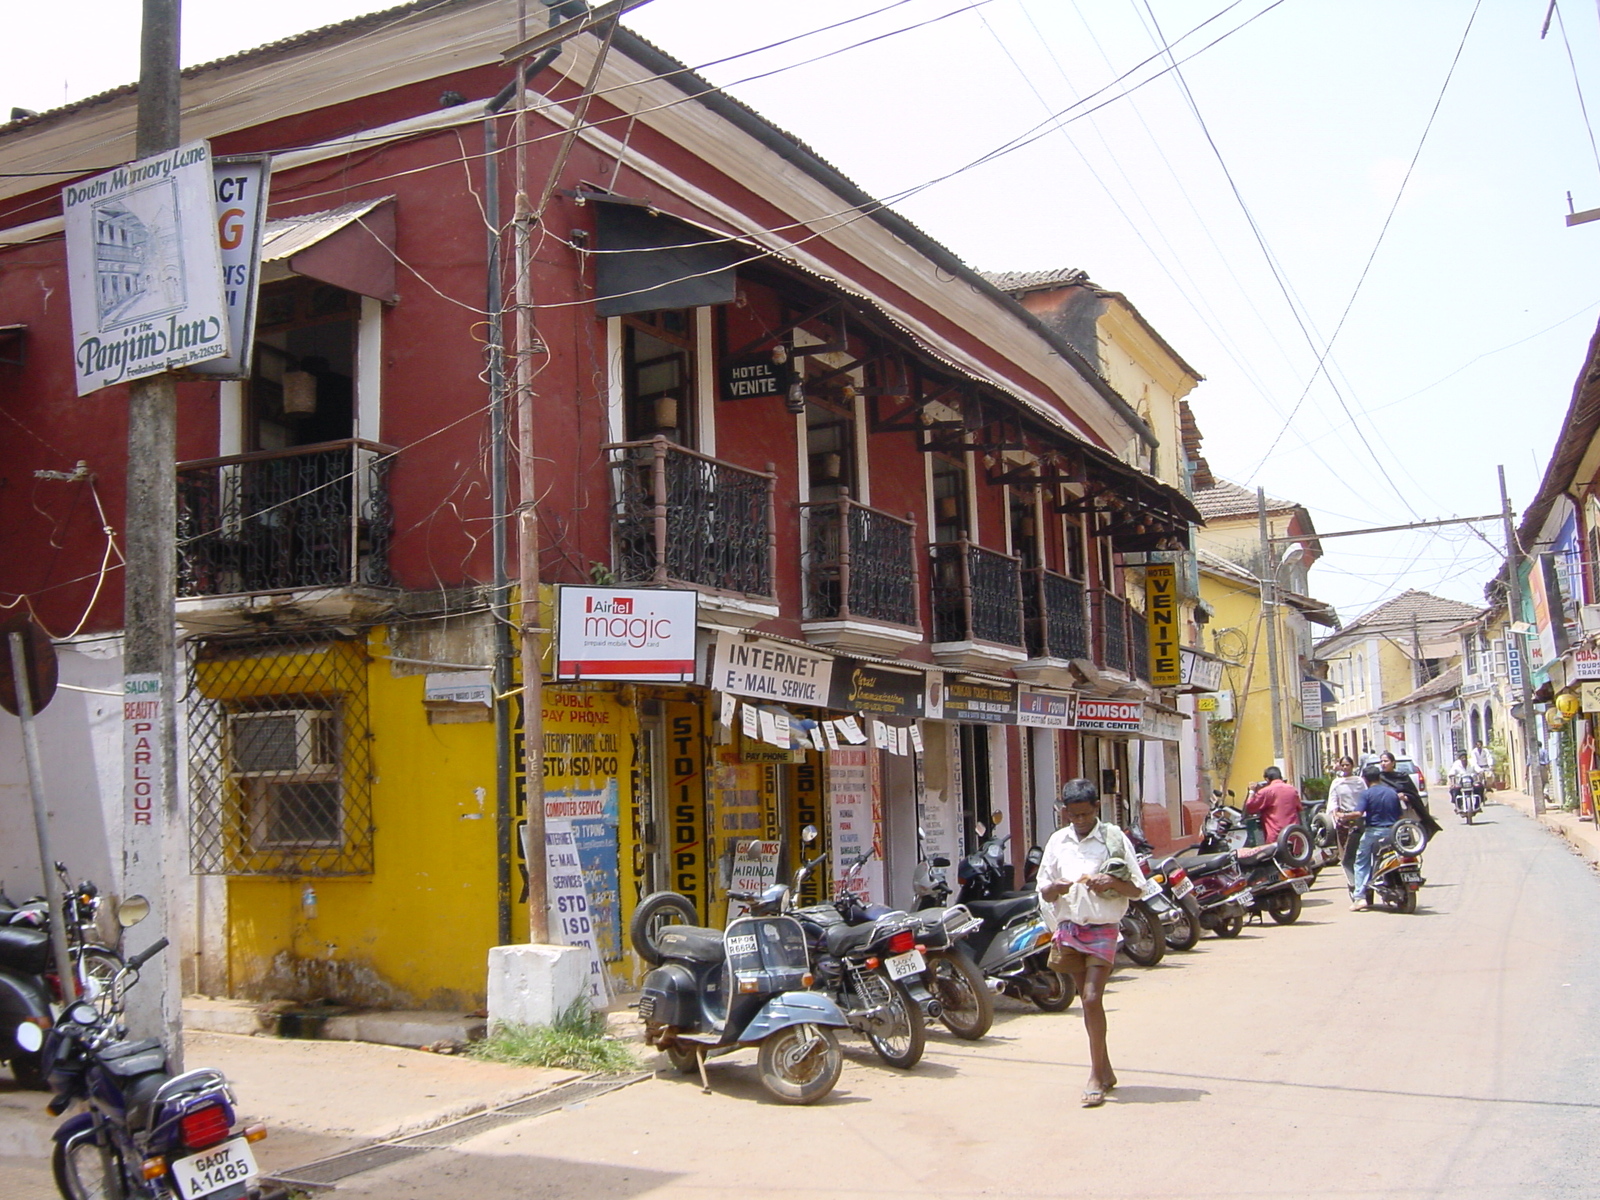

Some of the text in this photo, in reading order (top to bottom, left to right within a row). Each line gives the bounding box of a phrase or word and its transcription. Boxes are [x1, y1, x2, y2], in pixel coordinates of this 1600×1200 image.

[66, 180, 107, 208] Down
[172, 146, 207, 171] Lane
[139, 321, 154, 332] the
[77, 314, 221, 387] Panjim Inn
[732, 364, 773, 379] HOTEL
[730, 377, 777, 396] VENITE
[1147, 567, 1173, 577] HOTEL
[593, 599, 631, 614] Airtel
[584, 611, 672, 649] magic
[1152, 579, 1175, 673] VENITE
[584, 640, 607, 648] prepaid
[728, 643, 820, 678] INTERNET
[1507, 642, 1522, 685] LODGE
[1575, 649, 1600, 662] COAS
[781, 678, 817, 701] SERVICE
[554, 693, 595, 708] PUBLIC
[124, 701, 160, 721] BEAUTY
[542, 709, 610, 724] PAY PHONE
[1077, 703, 1141, 719] HOMSON
[1106, 721, 1140, 731] CENTER
[542, 732, 619, 754] NTERNATIONAL CALL
[745, 752, 761, 761] PAY
[762, 751, 789, 761] PHONE
[132, 722, 152, 826] PARLOUR
[543, 756, 619, 778] STD/ISD/PCO
[545, 800, 578, 818] COMPUTER
[869, 747, 884, 860] KONKAN
[760, 842, 780, 855] INKS
[548, 853, 578, 868] E-MAIL
[733, 865, 775, 878] MIRINDA
[552, 874, 583, 890] SERVICES
[738, 878, 768, 891] Slice
[557, 894, 587, 913] STD
[562, 916, 591, 936] ISD
[189, 1159, 250, 1196] A-1485
